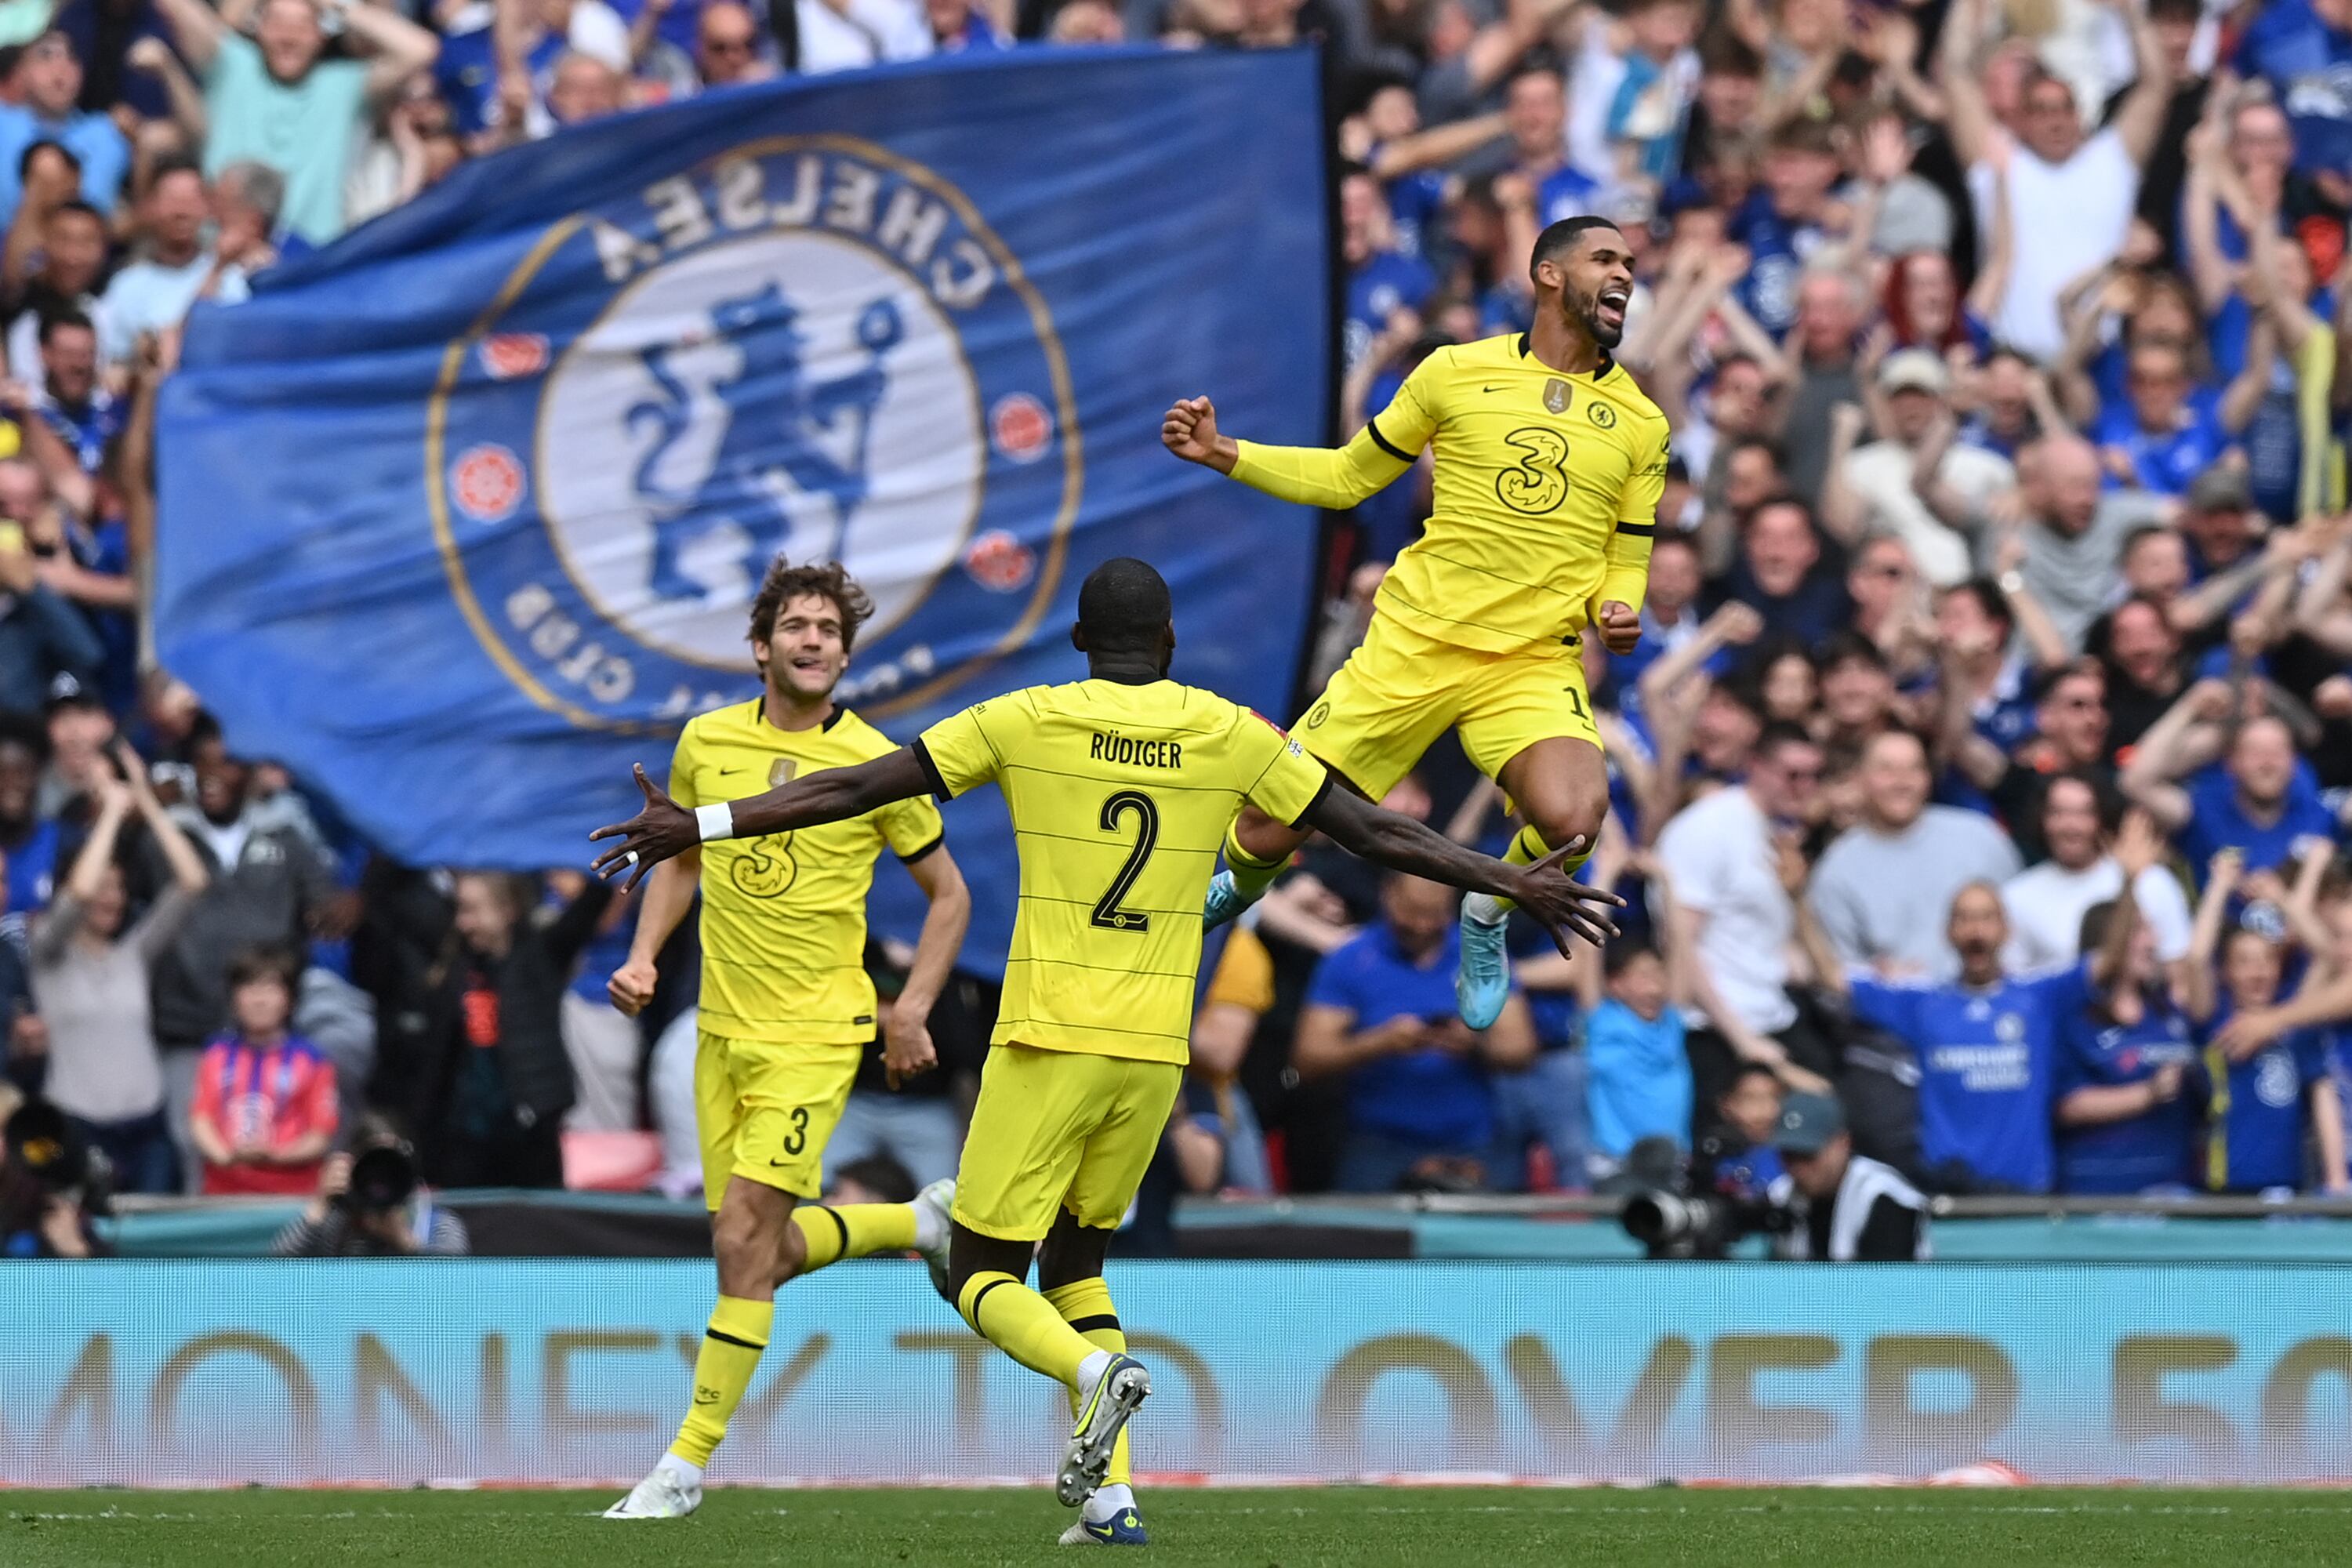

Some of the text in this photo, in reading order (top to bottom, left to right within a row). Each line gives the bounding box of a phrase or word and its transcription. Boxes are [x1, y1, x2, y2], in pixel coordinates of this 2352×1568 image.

[1091, 729, 1181, 769] RÜDIGER
[1088, 788, 1161, 935] 2
[783, 1106, 809, 1156] 3
[1316, 1328, 2021, 1483] OVER
